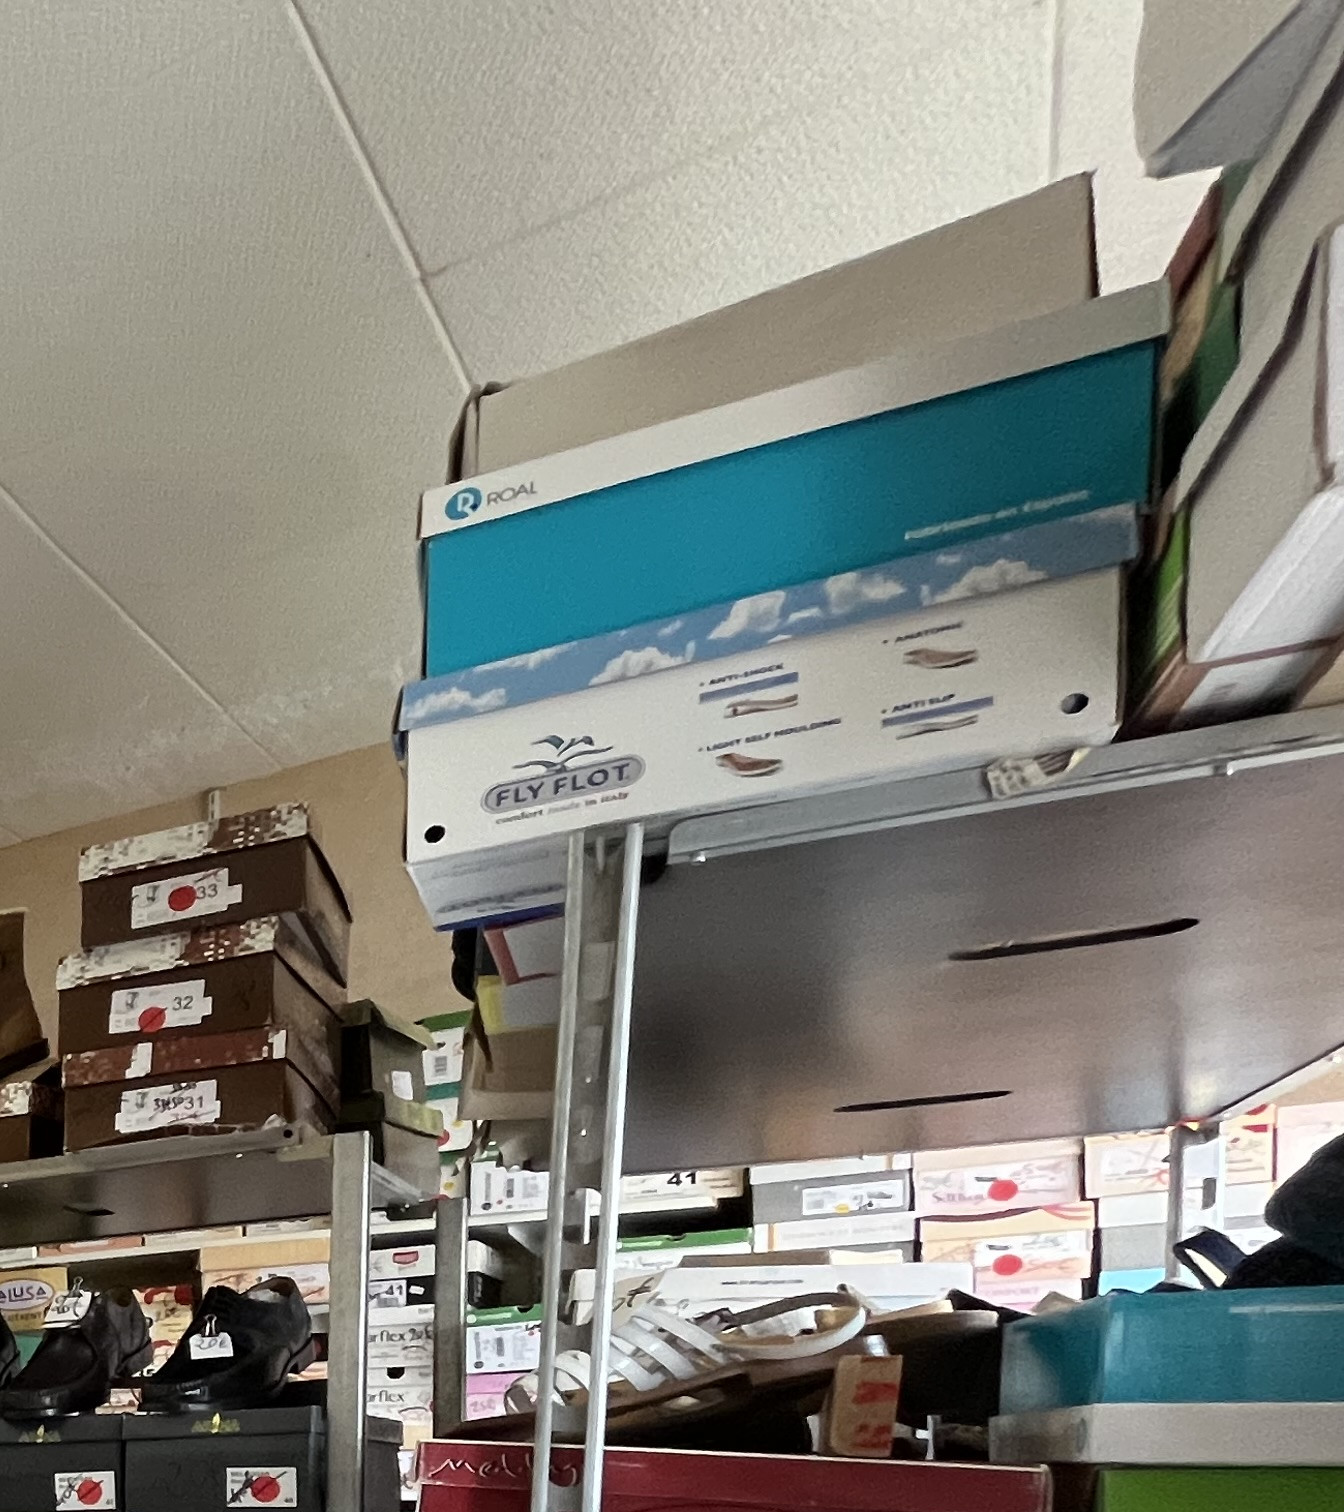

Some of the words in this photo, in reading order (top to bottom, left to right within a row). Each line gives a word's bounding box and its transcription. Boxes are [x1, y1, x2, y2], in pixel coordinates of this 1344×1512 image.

[487, 481, 537, 507] ROAL
[495, 780, 548, 807] FLY
[553, 763, 630, 795] FLOT
[195, 883, 219, 900] 33
[173, 996, 194, 1011] 32
[666, 1172, 698, 1186] 41
